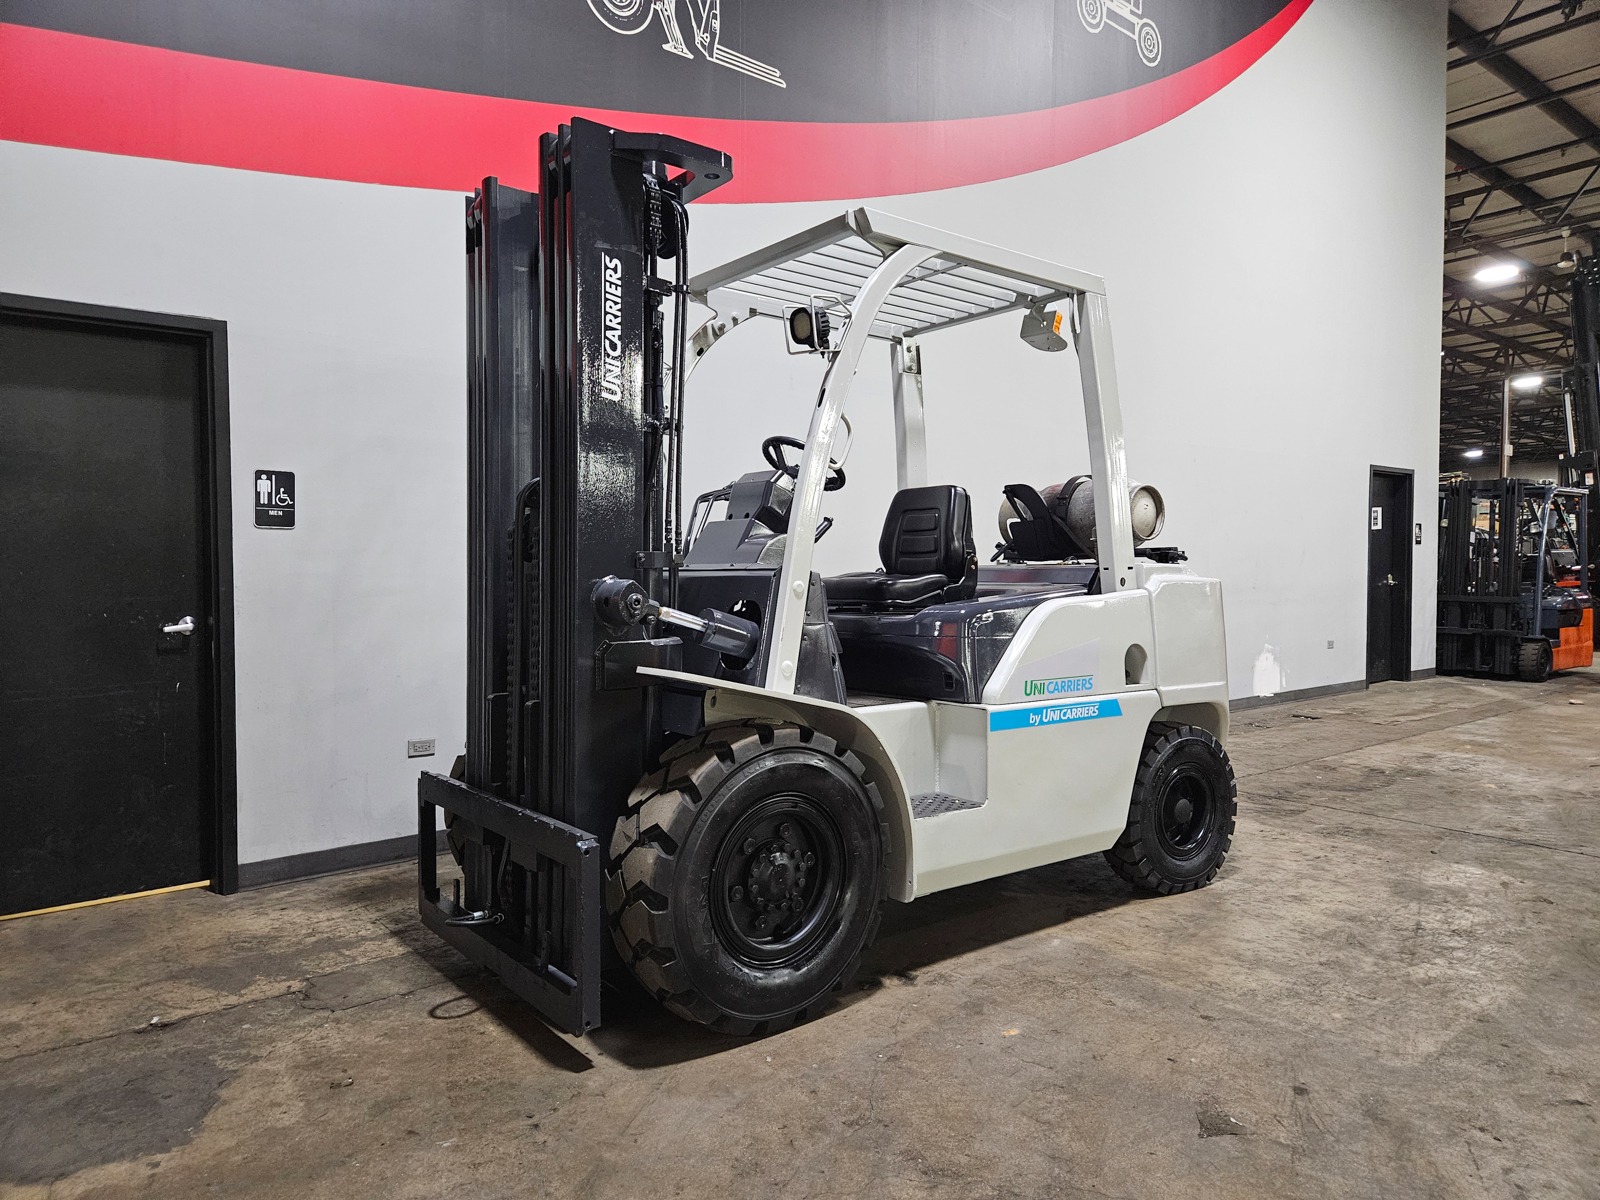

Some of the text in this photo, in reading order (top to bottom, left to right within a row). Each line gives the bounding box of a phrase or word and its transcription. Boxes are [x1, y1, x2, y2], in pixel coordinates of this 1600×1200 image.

[602, 252, 622, 402] UNICARRIERS
[1024, 676, 1094, 696] UNICARRIERS
[1029, 704, 1100, 726] by UNICARRIERS
